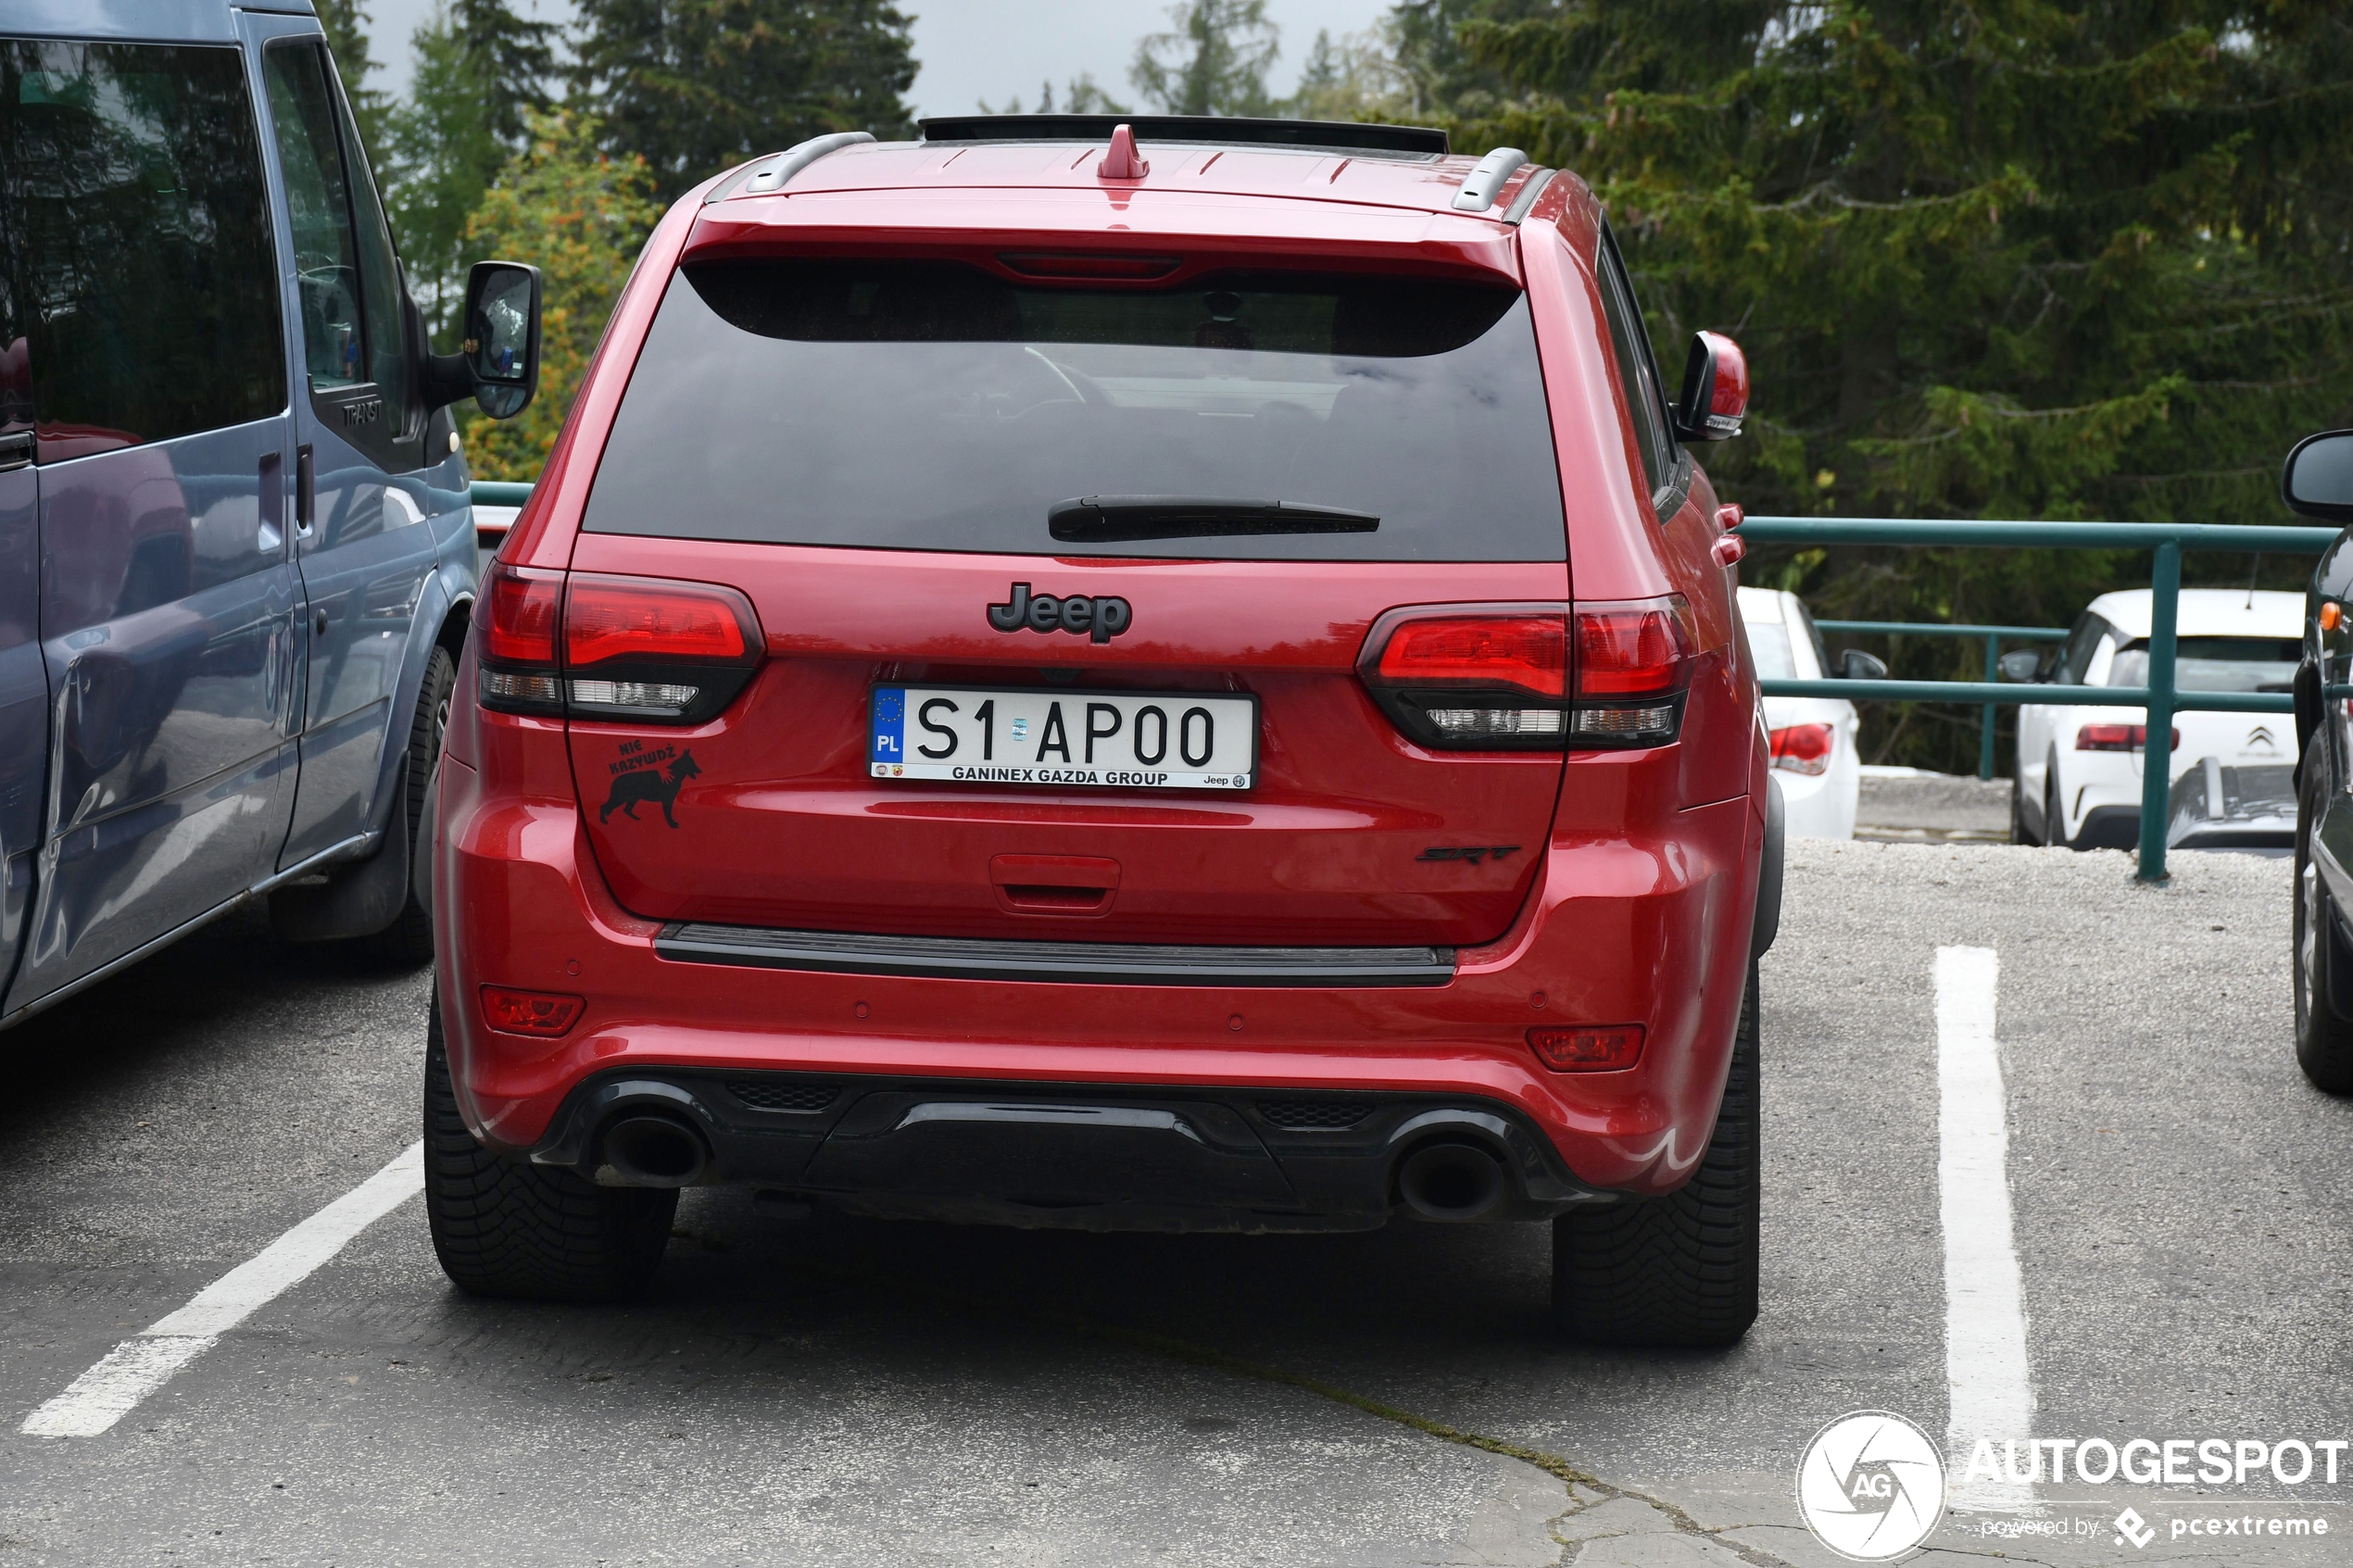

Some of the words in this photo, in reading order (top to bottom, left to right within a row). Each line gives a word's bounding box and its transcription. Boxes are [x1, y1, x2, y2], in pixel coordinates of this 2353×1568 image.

[343, 399, 382, 426] TRANSIT
[988, 583, 1130, 644] Jeep
[917, 697, 994, 759] S1
[618, 739, 643, 756] NIE
[876, 734, 900, 752] PL
[952, 766, 1033, 782] GANINEX
[1038, 770, 1099, 784] GAZDA
[1105, 771, 1168, 785] GROUP
[1203, 775, 1228, 785] Jeep
[1416, 845, 1521, 865] SRT
